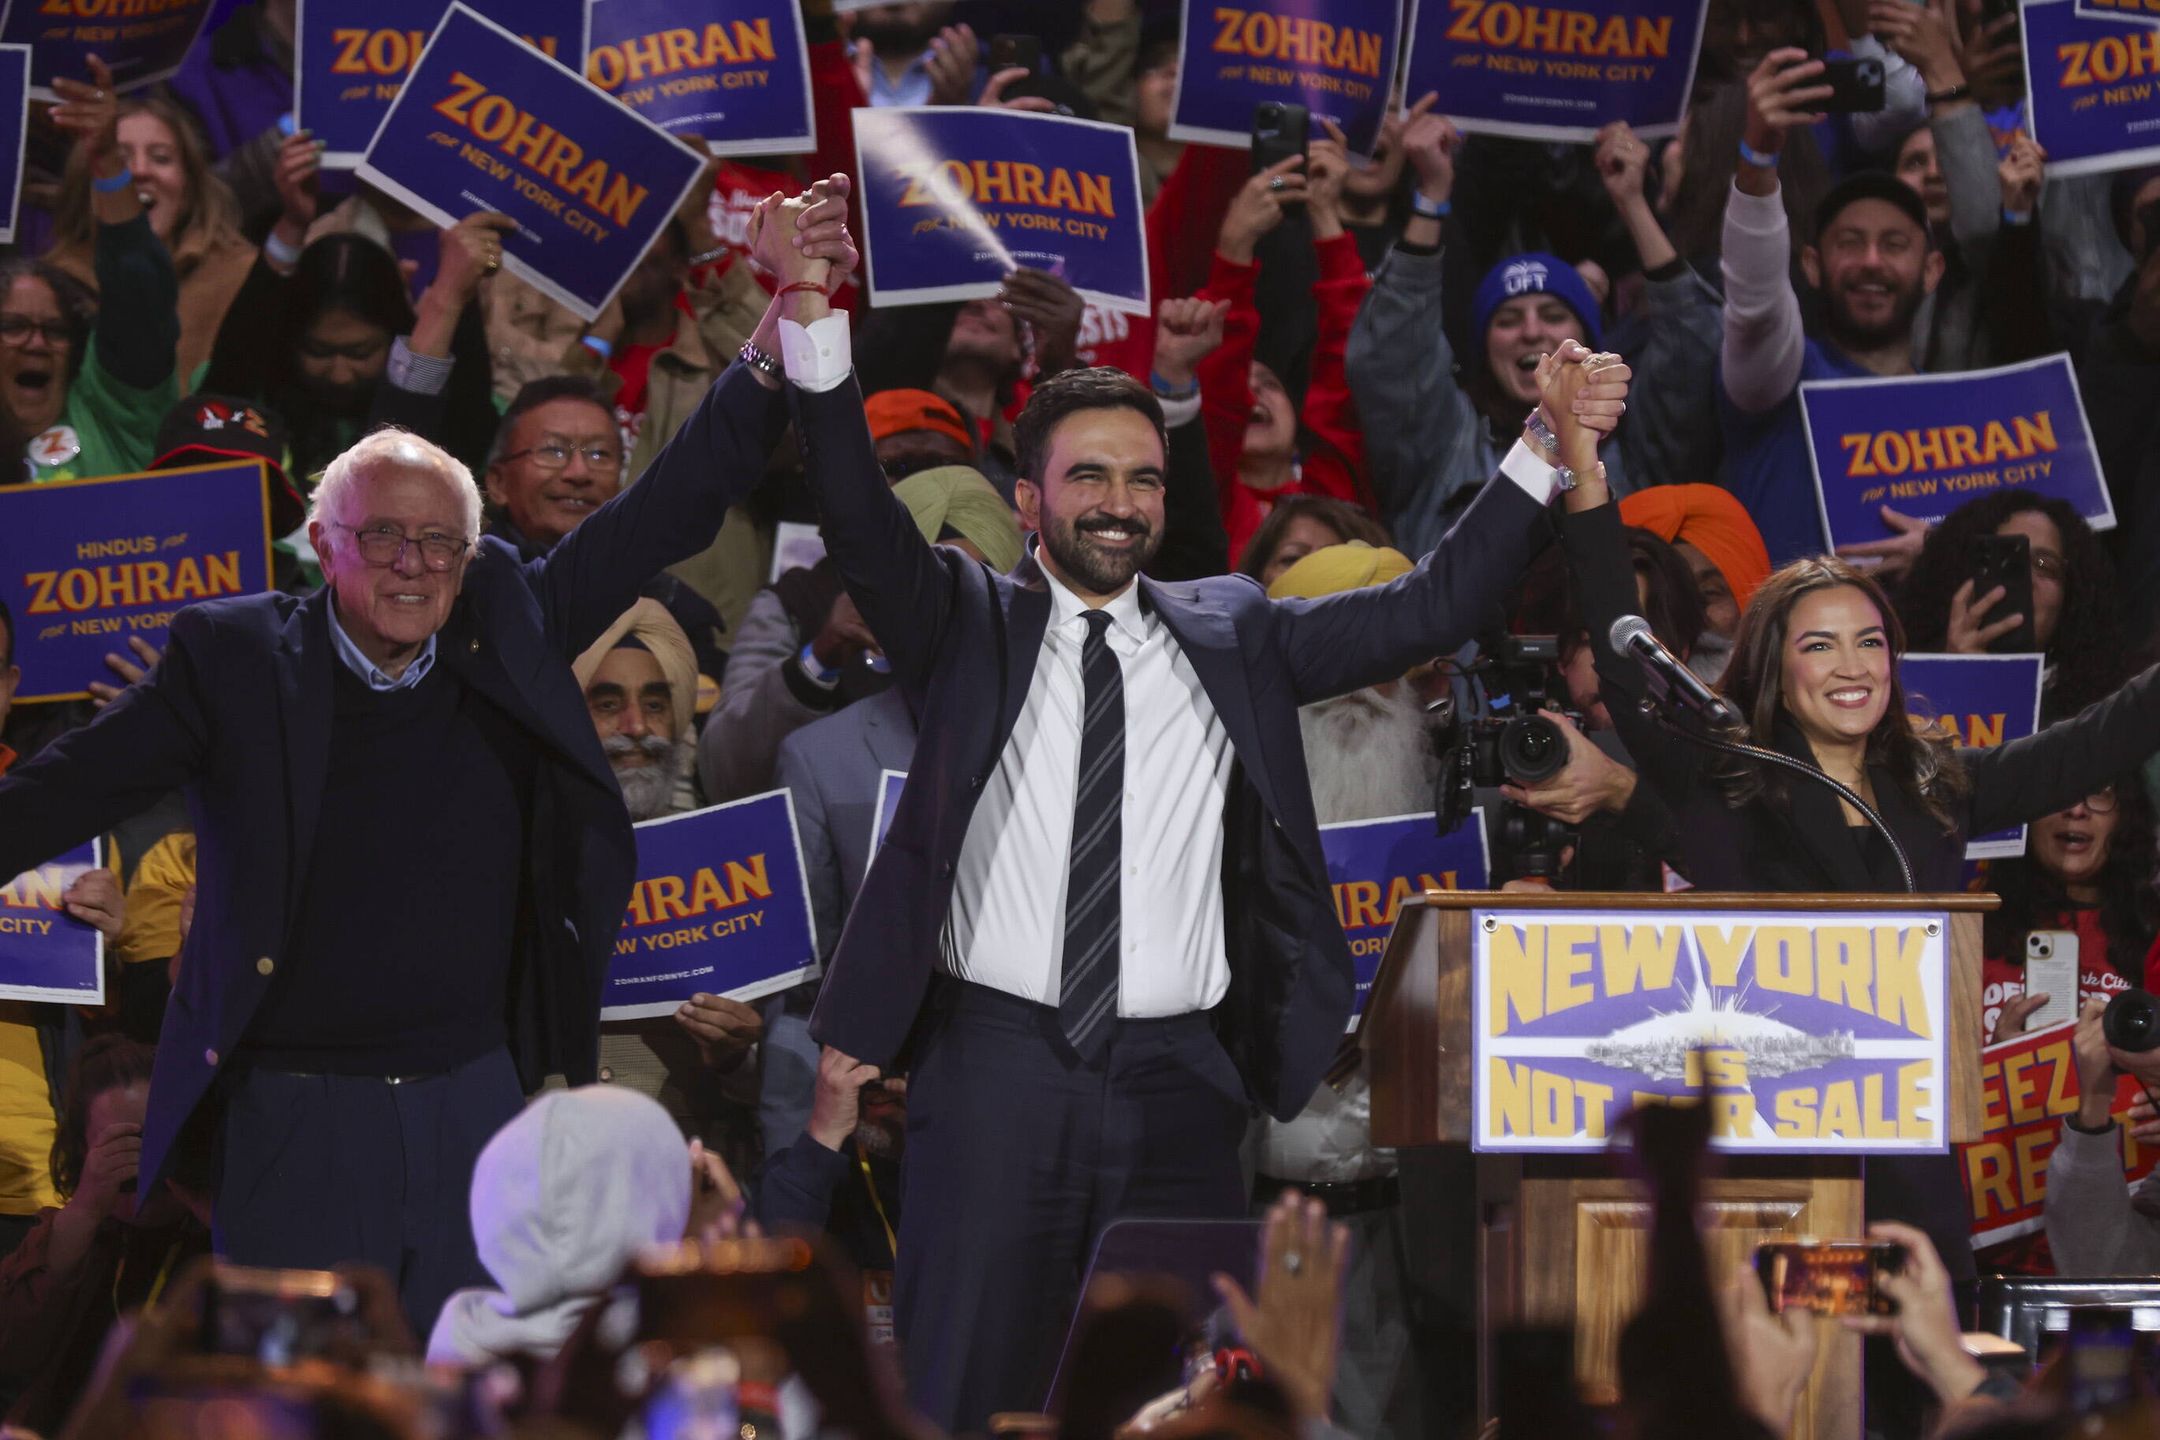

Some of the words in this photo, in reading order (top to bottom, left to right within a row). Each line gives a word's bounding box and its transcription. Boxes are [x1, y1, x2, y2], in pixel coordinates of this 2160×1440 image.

[1211, 6, 1382, 78] ZOHRAN
[1446, 0, 1674, 58] ZOHRAN
[586, 17, 777, 91] OHRAN
[1485, 53, 1539, 74] NEW
[1544, 60, 1601, 80] YORK
[1605, 64, 1655, 81] CITY
[2058, 31, 2160, 88] ZOH
[618, 86, 655, 108] EW
[659, 73, 719, 98] YORK
[721, 70, 769, 89] CITY
[1248, 67, 1294, 86] NEW
[1299, 72, 1341, 92] YORK
[1343, 80, 1374, 99] CITY
[2103, 83, 2152, 105] NEW
[432, 70, 649, 230] ZOHRAN
[459, 142, 514, 182] NEW
[512, 172, 568, 217] YORK
[562, 203, 611, 243] CITY
[896, 158, 1117, 219] ZOHRAN
[1005, 212, 1063, 234] YORK
[1064, 218, 1109, 242] CITY
[1504, 271, 1547, 296] UFT
[1840, 410, 2058, 478] ZOHRAN
[1890, 478, 1938, 499] NEW
[1942, 471, 2001, 493] YORK
[2002, 460, 2053, 485] CITY
[76, 535, 157, 560] HINDUS
[24, 551, 243, 615] ZOHRAN
[71, 616, 123, 636] NEW
[0, 918, 53, 935] CITY
[641, 925, 709, 951] YORK
[711, 910, 765, 938] CITY
[613, 965, 715, 986] ZOHRANFORNYC.COM
[1489, 924, 1684, 1038] NEW
[1693, 925, 1934, 1041] YORK
[1685, 1048, 1748, 1087] IS
[1489, 1056, 1614, 1138] NOT
[1775, 1058, 1934, 1139] SALE
[1965, 1109, 2141, 1220] RET
